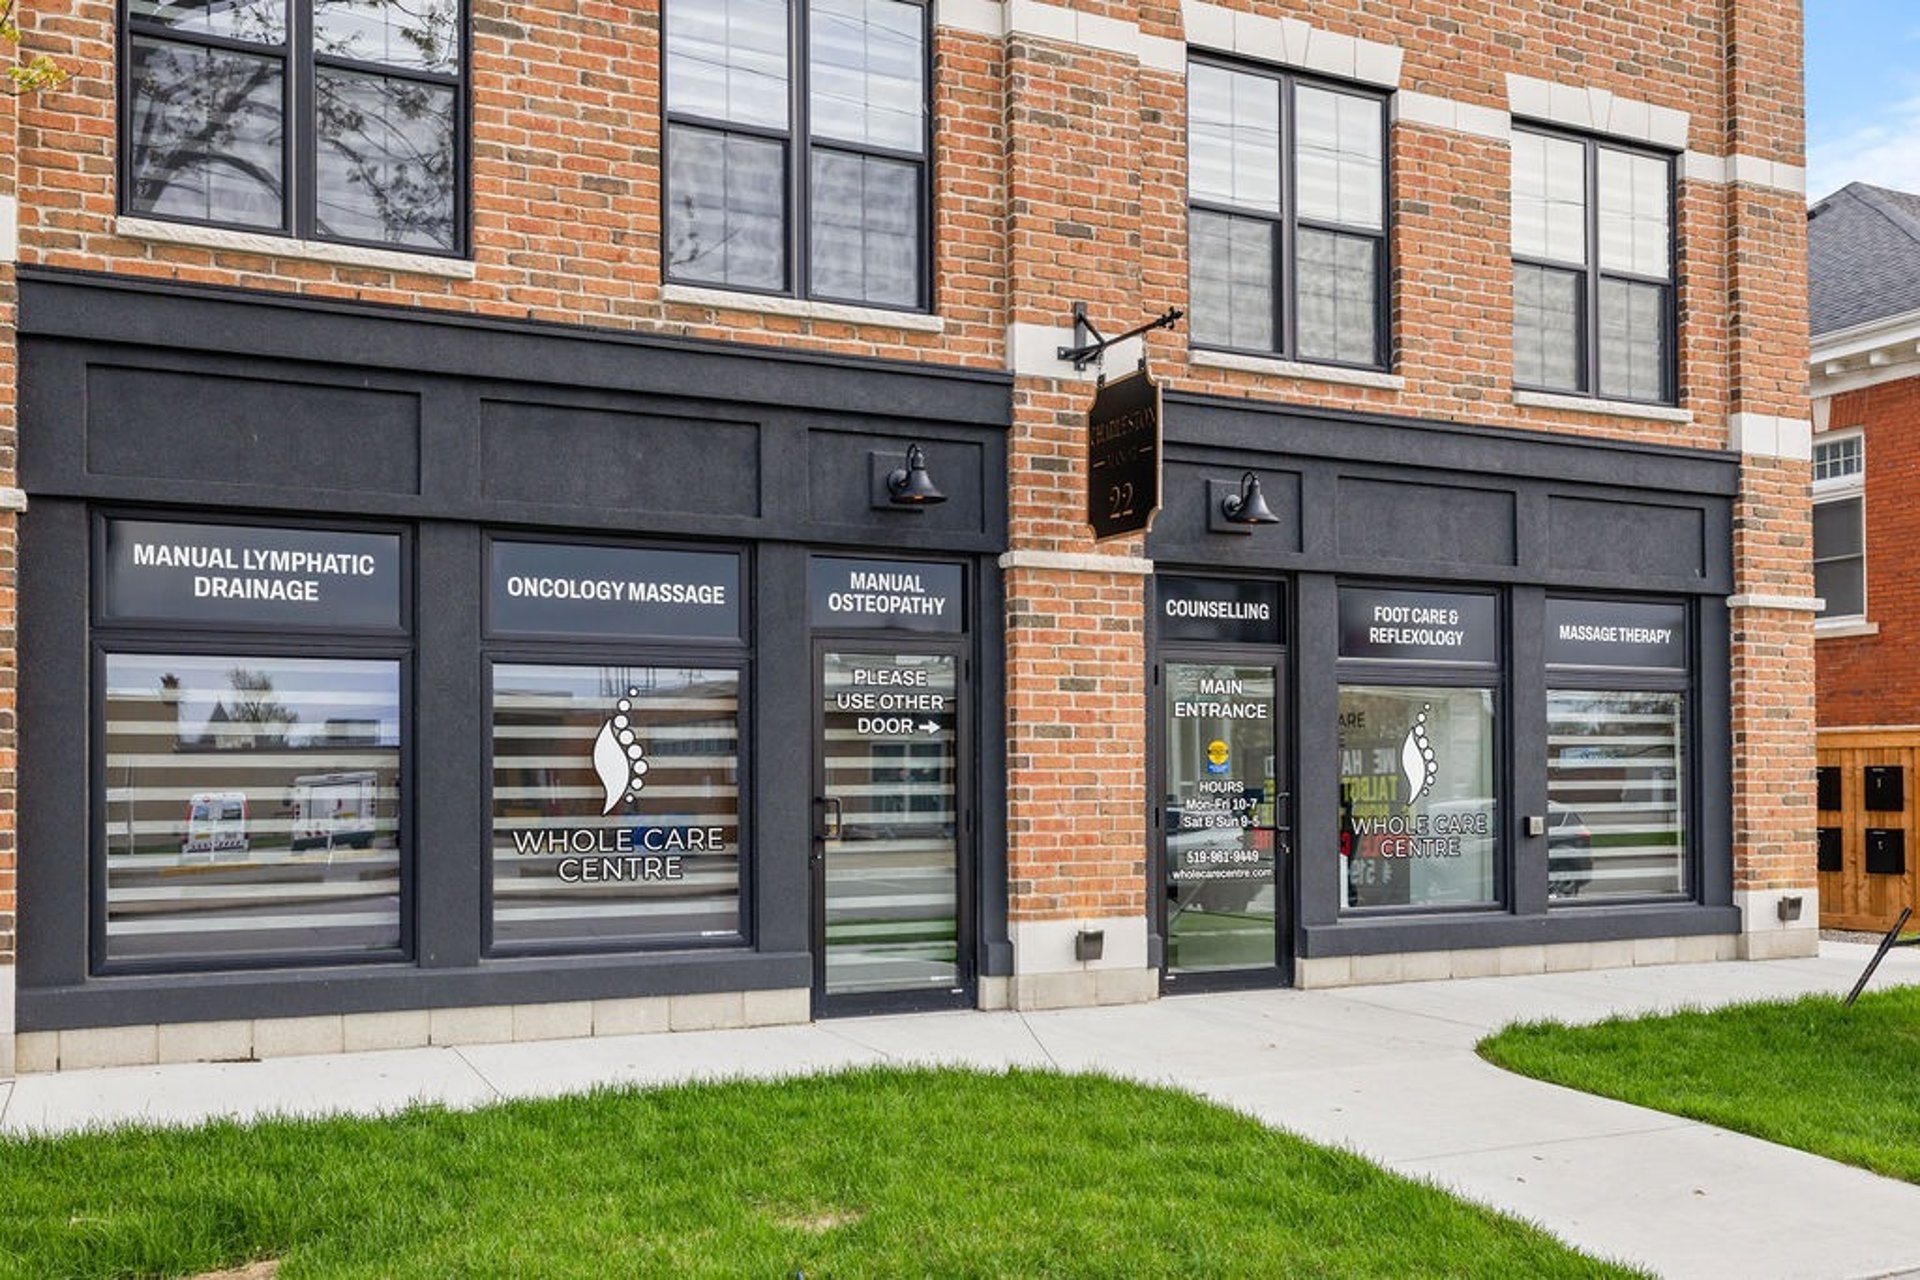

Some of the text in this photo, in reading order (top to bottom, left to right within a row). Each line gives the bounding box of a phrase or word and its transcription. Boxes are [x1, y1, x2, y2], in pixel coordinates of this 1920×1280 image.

[1109, 482, 1134, 518] 22
[133, 543, 375, 576] MANUAL LYMPHATIC
[193, 575, 319, 602] DRAINAGE
[507, 576, 725, 605] ONCOLOGY MASSAGE
[850, 572, 925, 592] MANUAL
[828, 594, 945, 614] OSTEOPATHY
[1165, 598, 1270, 621] COUNSELLING
[1373, 605, 1458, 624] FOOT CARE &
[1369, 626, 1463, 646] REFLEXOLOGY
[1559, 624, 1672, 645] MASSAGE THERAPY
[853, 668, 928, 687] PLEASE
[1200, 679, 1243, 695] MAIN
[837, 693, 944, 711] USE OTHER
[1174, 702, 1267, 719] ENTRANCE
[857, 717, 914, 735] DOOR
[1198, 781, 1245, 793] HOURS
[1185, 798, 1257, 811] Mon-Fri 10-7
[1182, 816, 1203, 828] Sat
[1204, 816, 1214, 828] &
[1216, 816, 1239, 828] Sun
[1351, 814, 1488, 836] WHOLE CARE
[513, 827, 724, 855] WHOLE CARE
[1381, 838, 1461, 858] CENTRE
[558, 857, 684, 882] CENTRE
[1171, 868, 1273, 880] wholecarecentre.com
